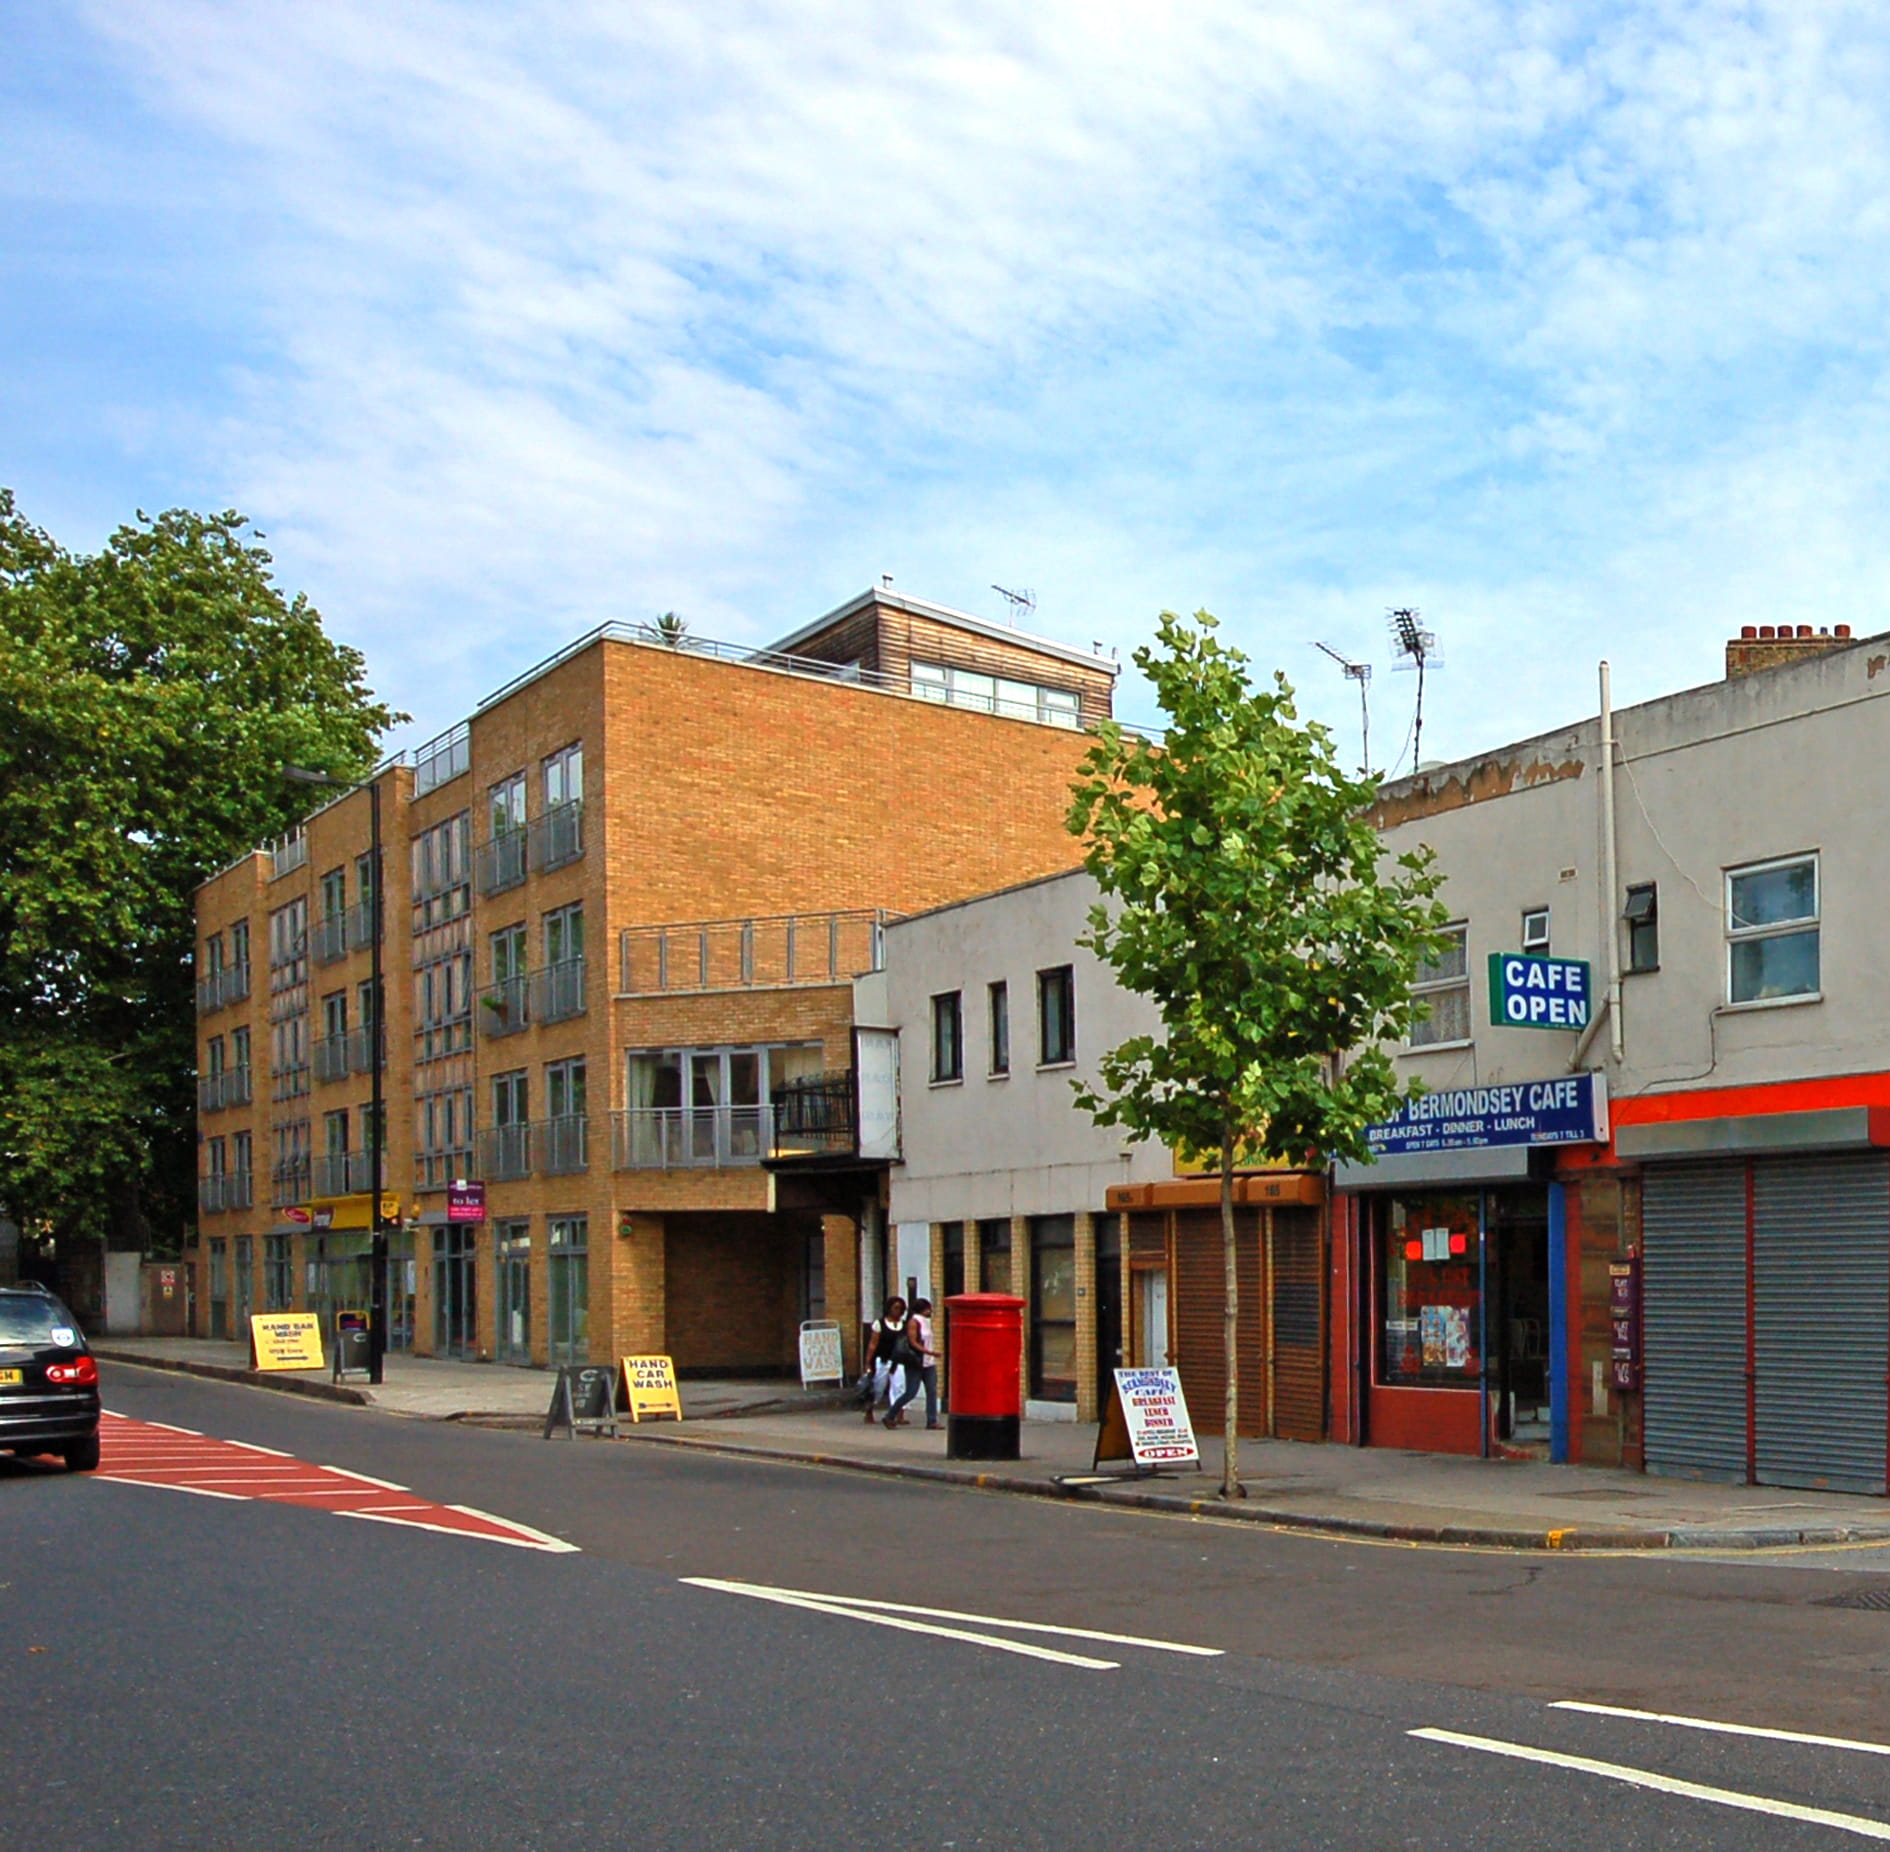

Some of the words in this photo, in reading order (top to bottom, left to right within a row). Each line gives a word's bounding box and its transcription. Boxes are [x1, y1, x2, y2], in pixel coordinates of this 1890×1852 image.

[1506, 961, 1582, 992] CAFE
[1507, 994, 1587, 1025] OPEN
[1408, 1085, 1524, 1121] BERMONDSEY
[1530, 1081, 1578, 1111] CAFE
[1369, 1124, 1433, 1141] BREAKFAST
[1442, 1120, 1484, 1135] DINNER
[1494, 1116, 1535, 1131] LUNCH
[804, 1332, 840, 1344] HAND
[808, 1344, 836, 1356] CAR
[629, 1360, 668, 1368] HAND
[637, 1370, 665, 1378] CAR
[633, 1379, 672, 1388] WASH
[1132, 1396, 1176, 1406] BREAKFAST
[1144, 1418, 1174, 1428] DINNER
[1144, 1448, 1186, 1457] OPEN
